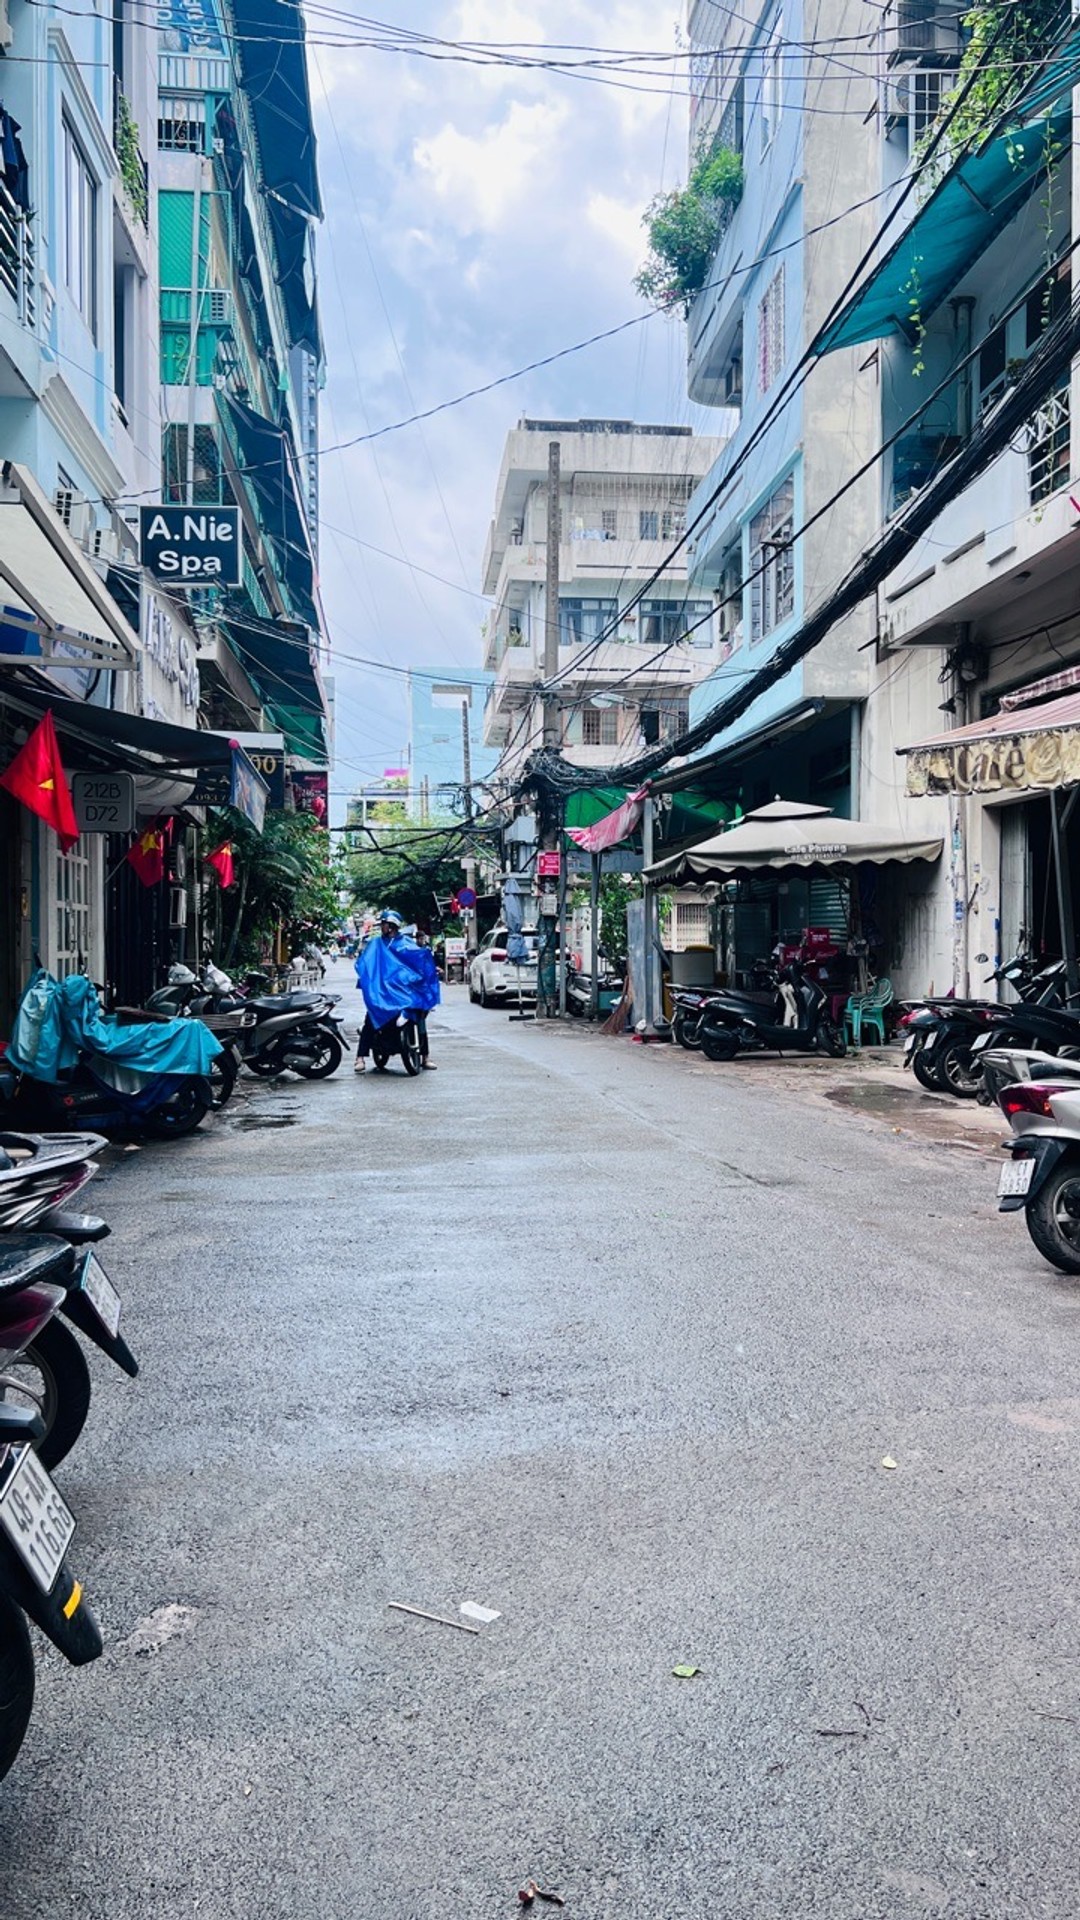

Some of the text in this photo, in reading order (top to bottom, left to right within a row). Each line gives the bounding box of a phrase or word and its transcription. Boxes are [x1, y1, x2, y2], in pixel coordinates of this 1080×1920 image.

[147, 514, 233, 541] A.Nie
[158, 550, 222, 576] Spa
[83, 781, 121, 799] 212B
[85, 805, 119, 822] D72
[6, 1460, 48, 1533] 48-AA
[29, 1493, 72, 1580] 116.66
